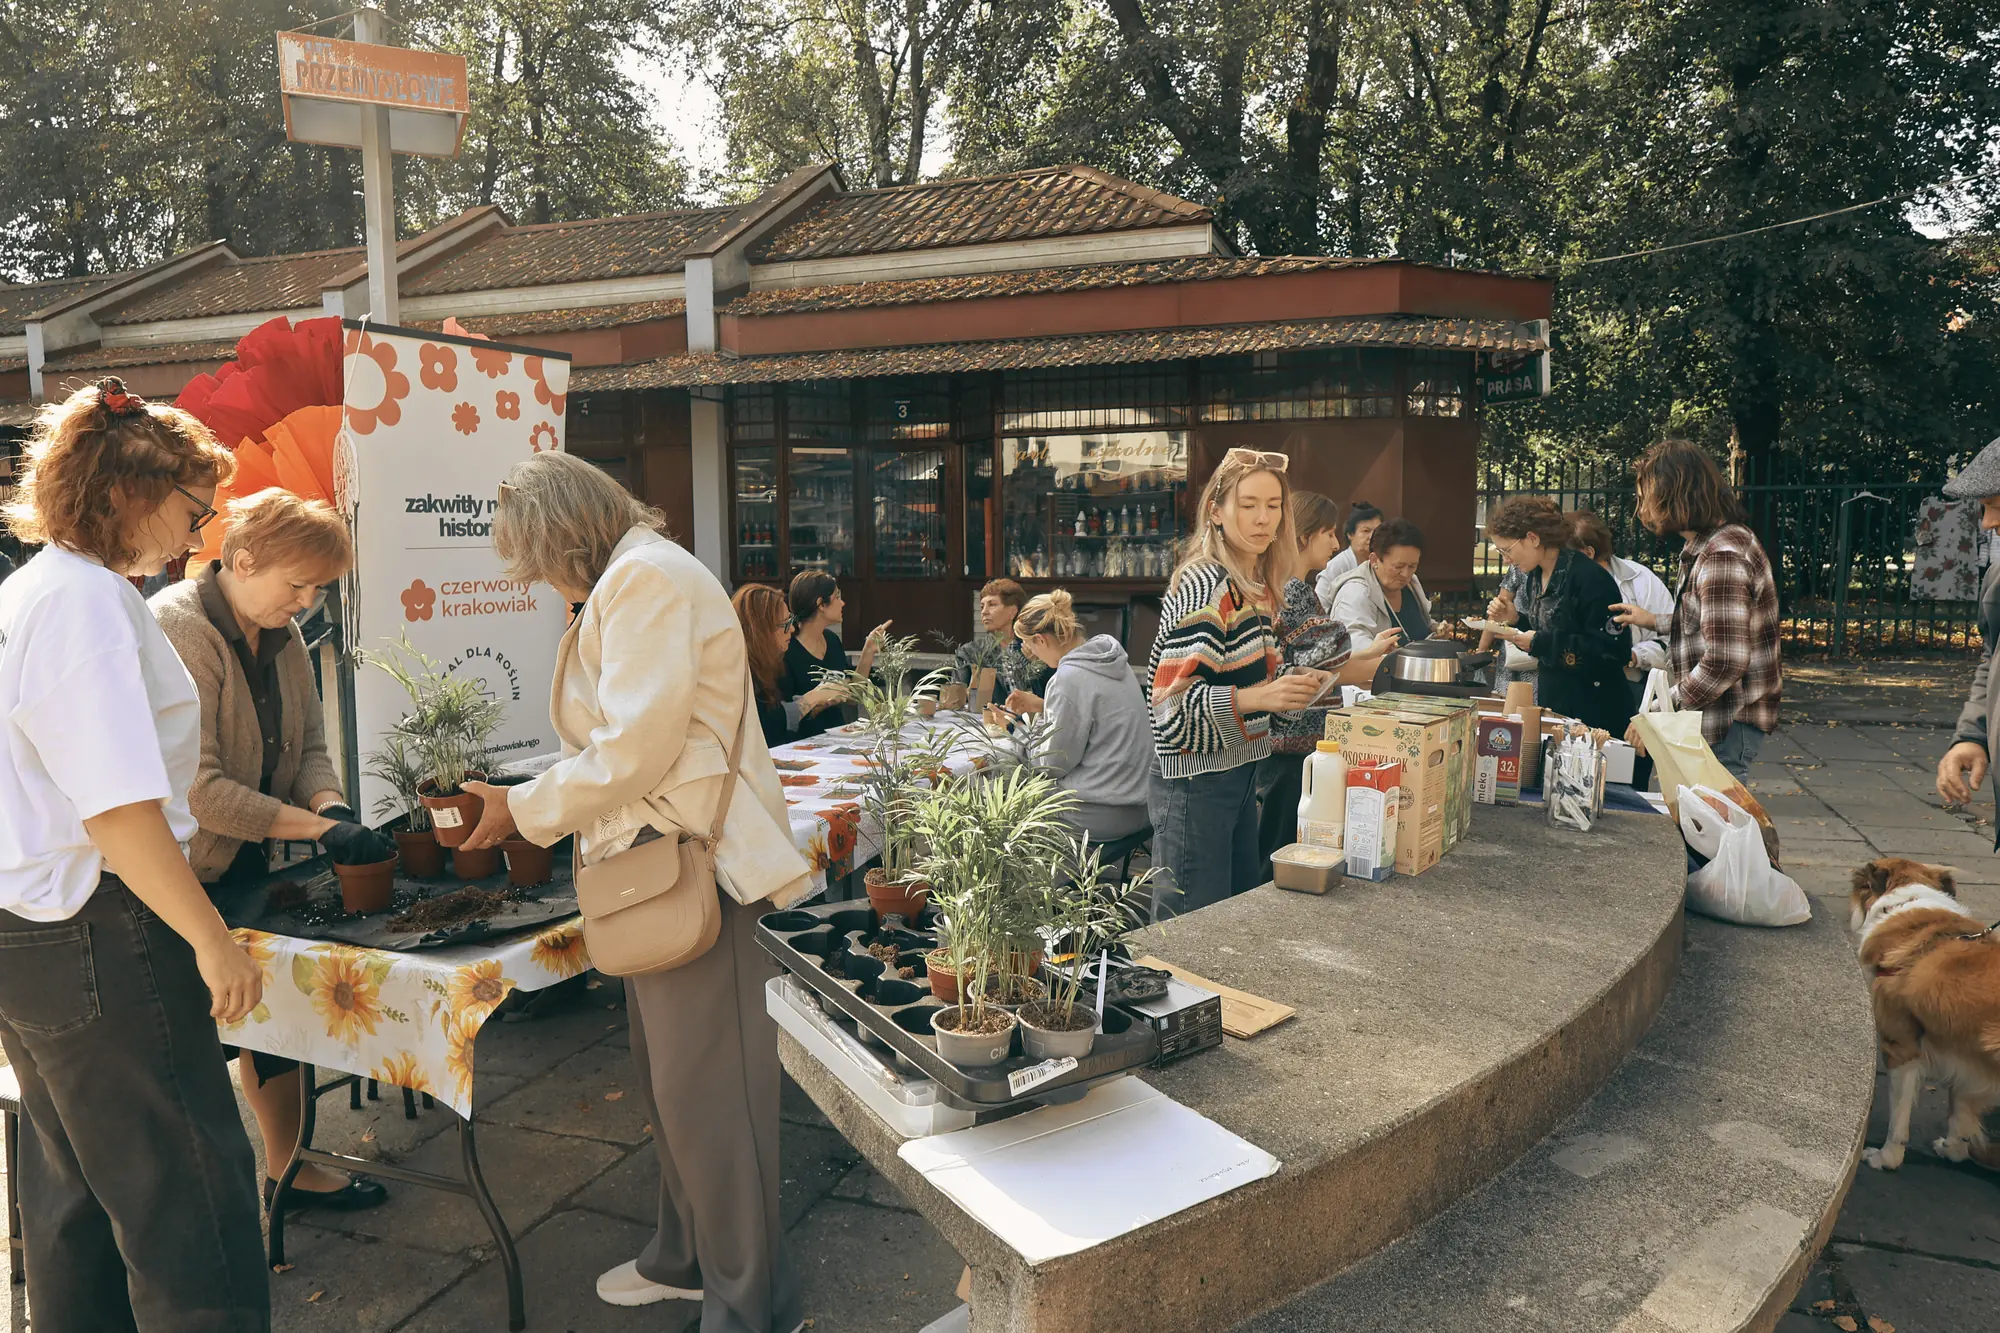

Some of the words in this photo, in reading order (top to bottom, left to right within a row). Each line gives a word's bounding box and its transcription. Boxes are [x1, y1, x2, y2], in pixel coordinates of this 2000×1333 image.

[1487, 376, 1532, 396] PRASA
[898, 405, 907, 418] 3
[441, 579, 531, 596] czerwony
[442, 595, 538, 617] krakowiak
[466, 646, 491, 658] DLA
[496, 652, 520, 700] ROŚLIN
[1477, 772, 1487, 802] mleko
